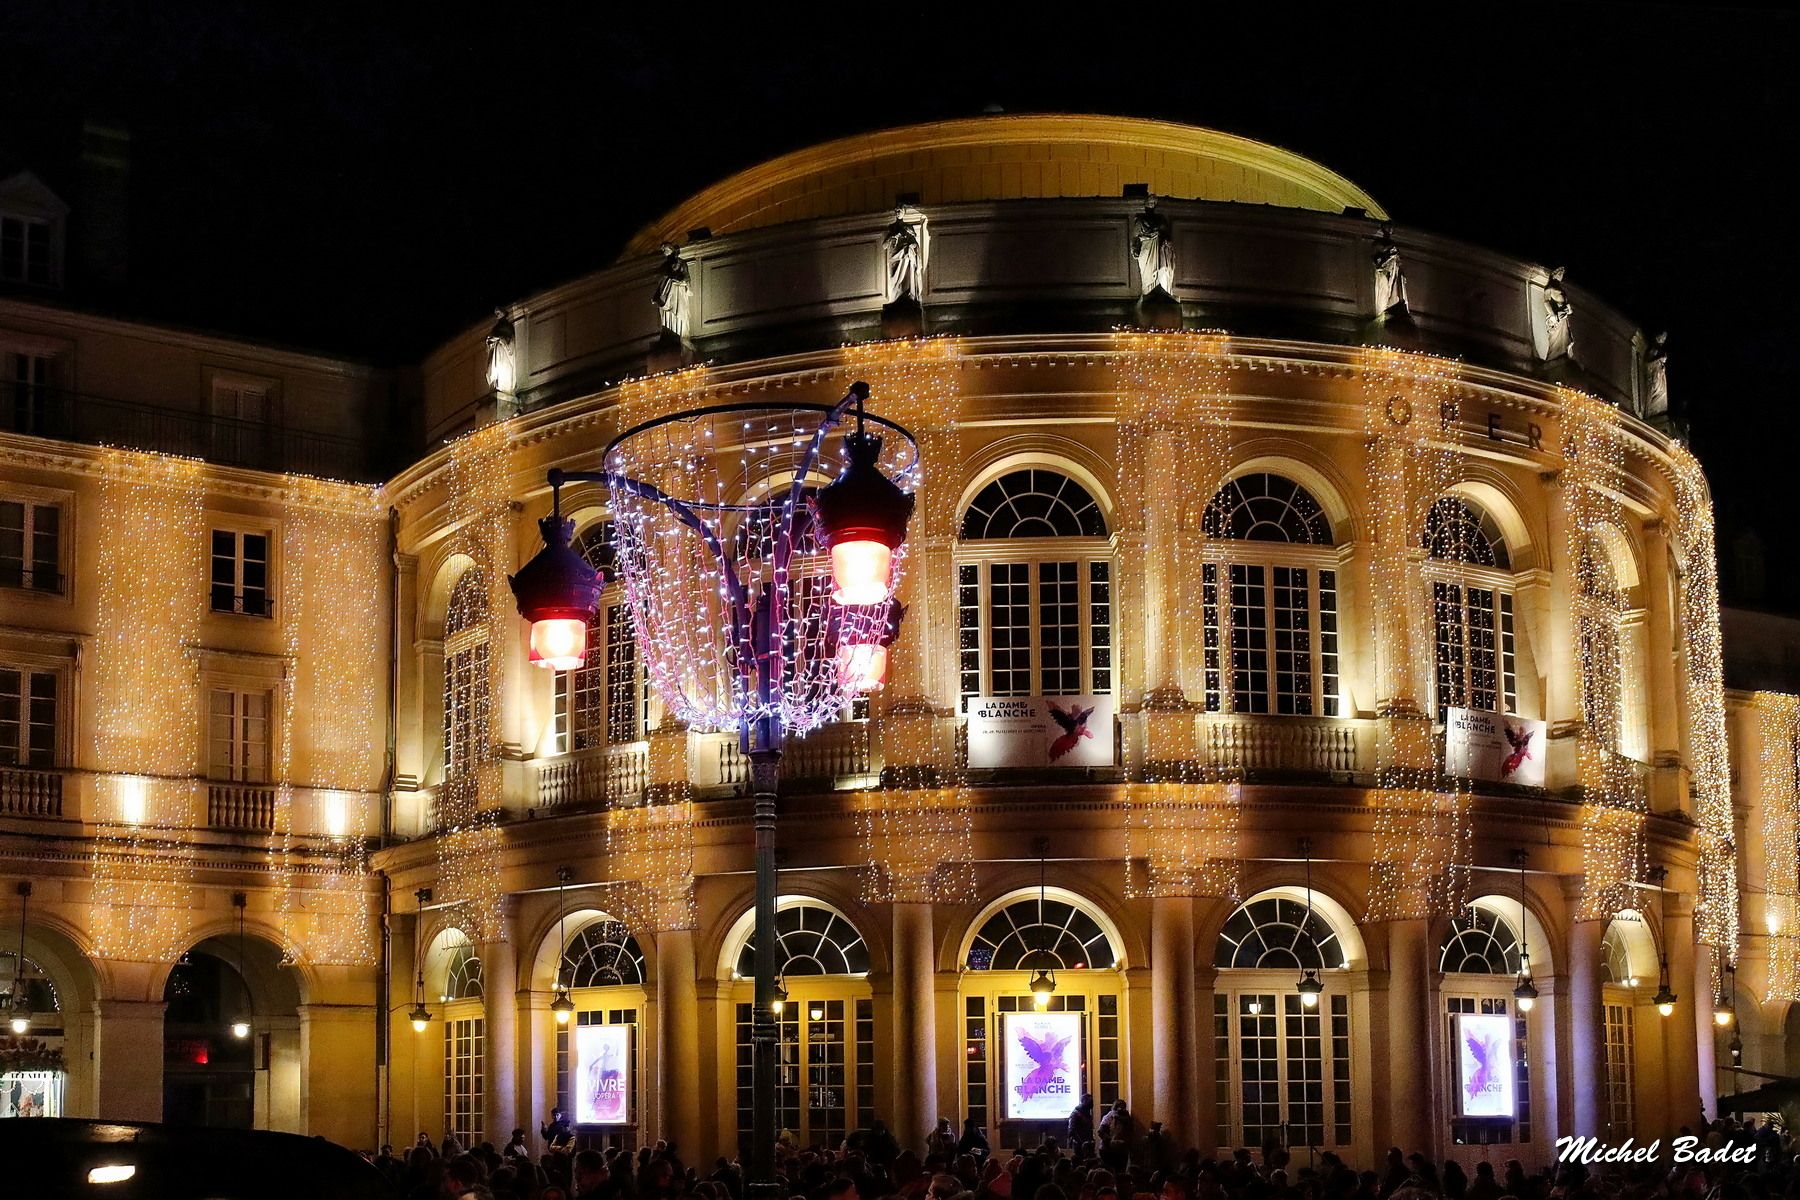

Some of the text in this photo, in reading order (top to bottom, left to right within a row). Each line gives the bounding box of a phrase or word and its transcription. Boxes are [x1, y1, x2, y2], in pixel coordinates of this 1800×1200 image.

[999, 701, 1028, 709] DAME
[978, 708, 1036, 718] BLANCHE
[1455, 721, 1495, 734] BLANCHE
[586, 1078, 625, 1092] VIVRE
[1014, 1084, 1071, 1094] BLANCHE
[1464, 1083, 1503, 1093] BANCHE
